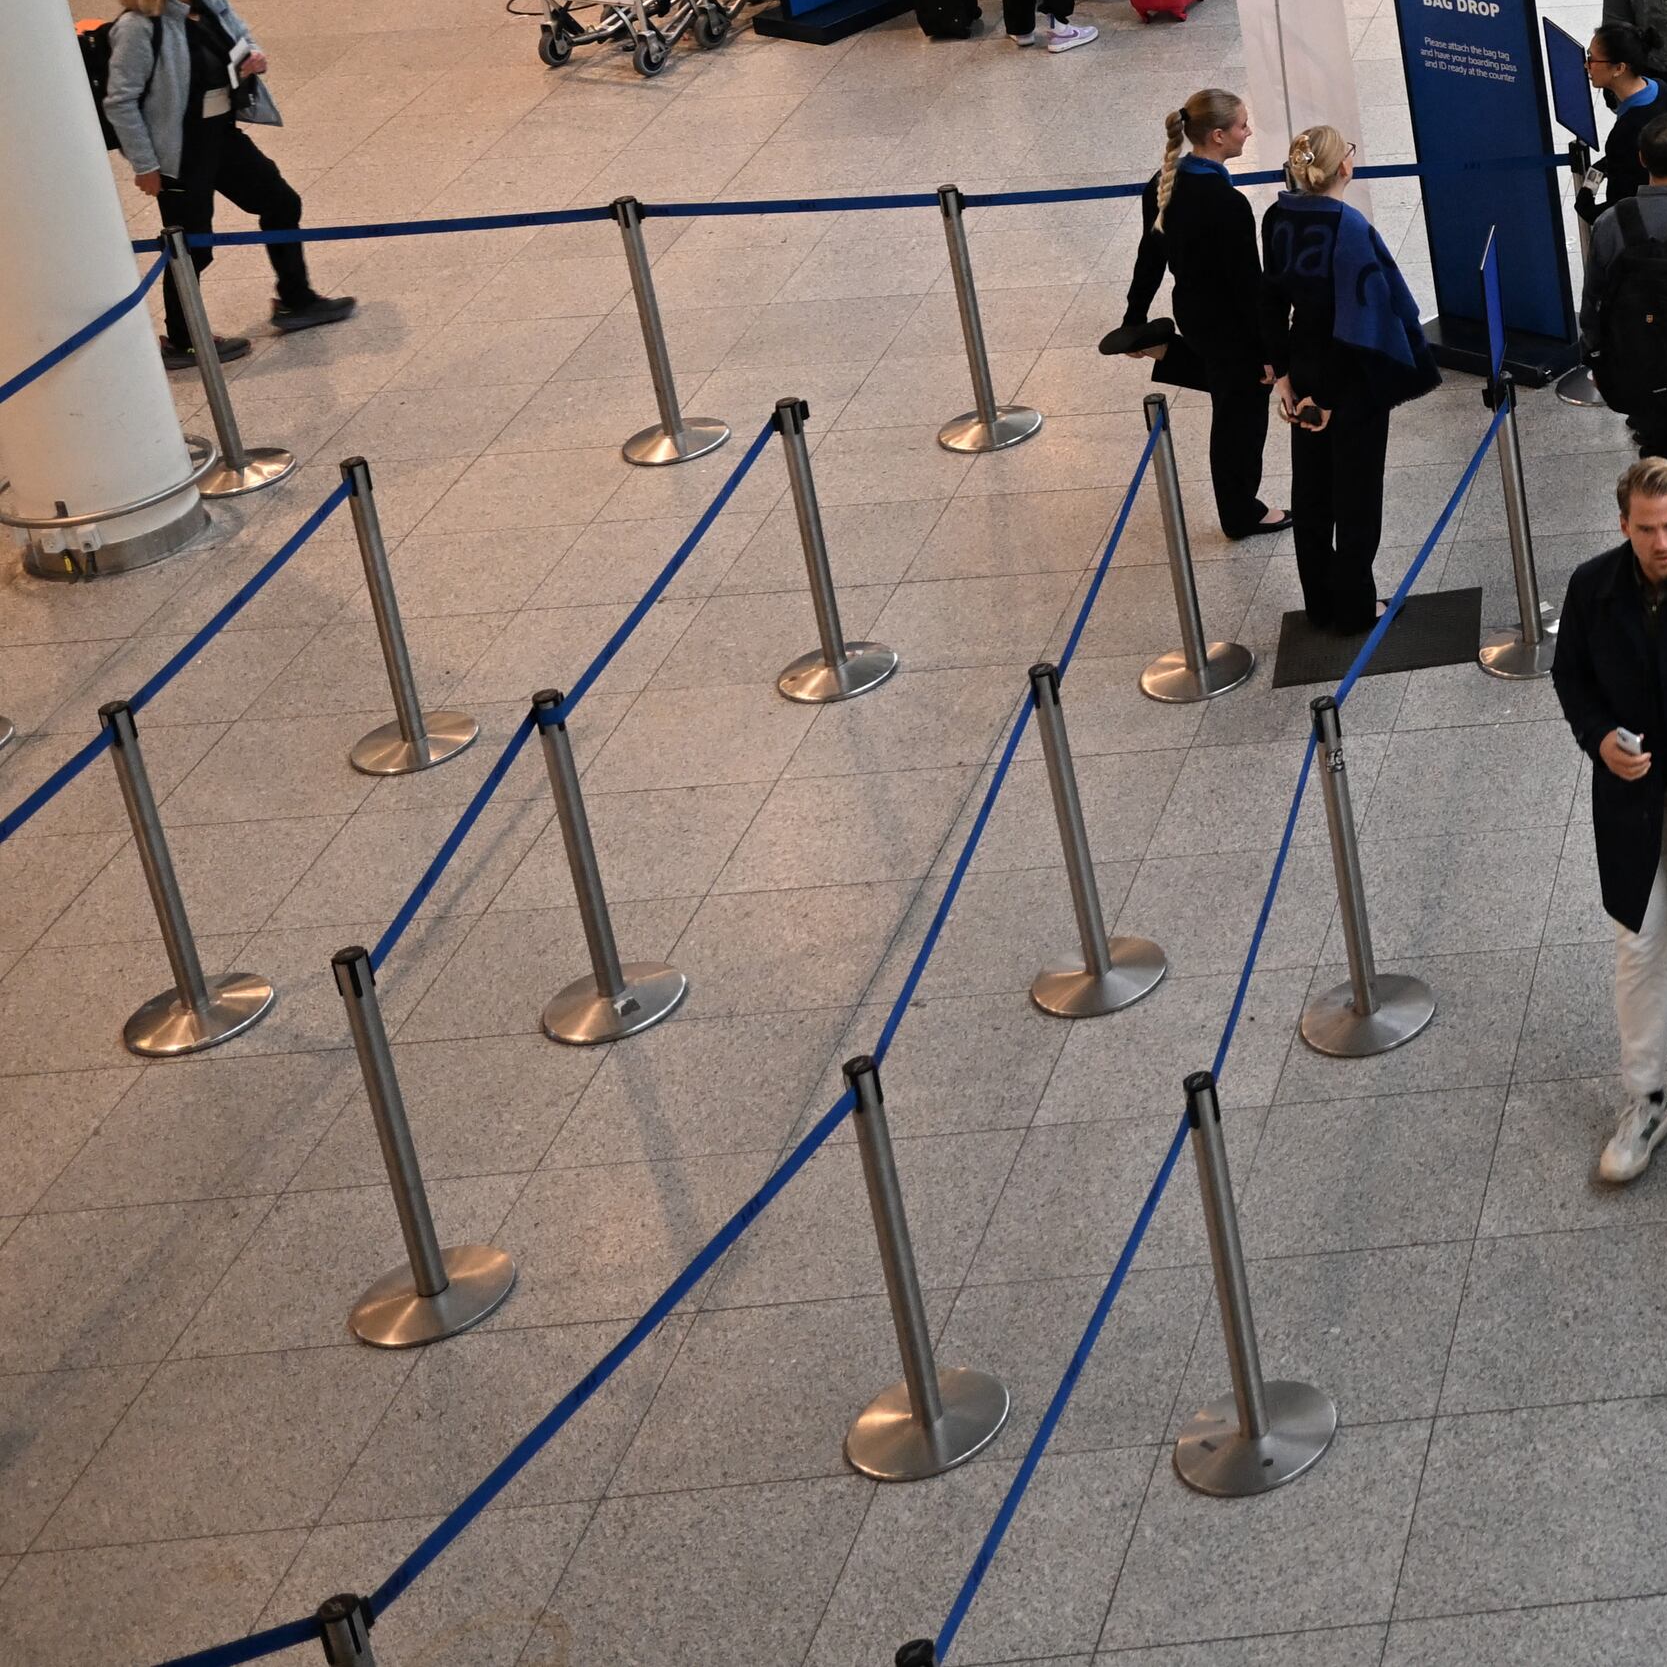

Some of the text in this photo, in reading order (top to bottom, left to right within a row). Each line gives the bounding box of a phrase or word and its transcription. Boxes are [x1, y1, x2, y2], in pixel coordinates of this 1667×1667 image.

[1420, 47, 1518, 73] and have your boarding pass
[1424, 36, 1510, 61] Please attach the bag tag
[1424, 59, 1439, 70] and
[1447, 63, 1468, 76] ready
[1475, 67, 1488, 78] the
[1488, 70, 1516, 83] counter
